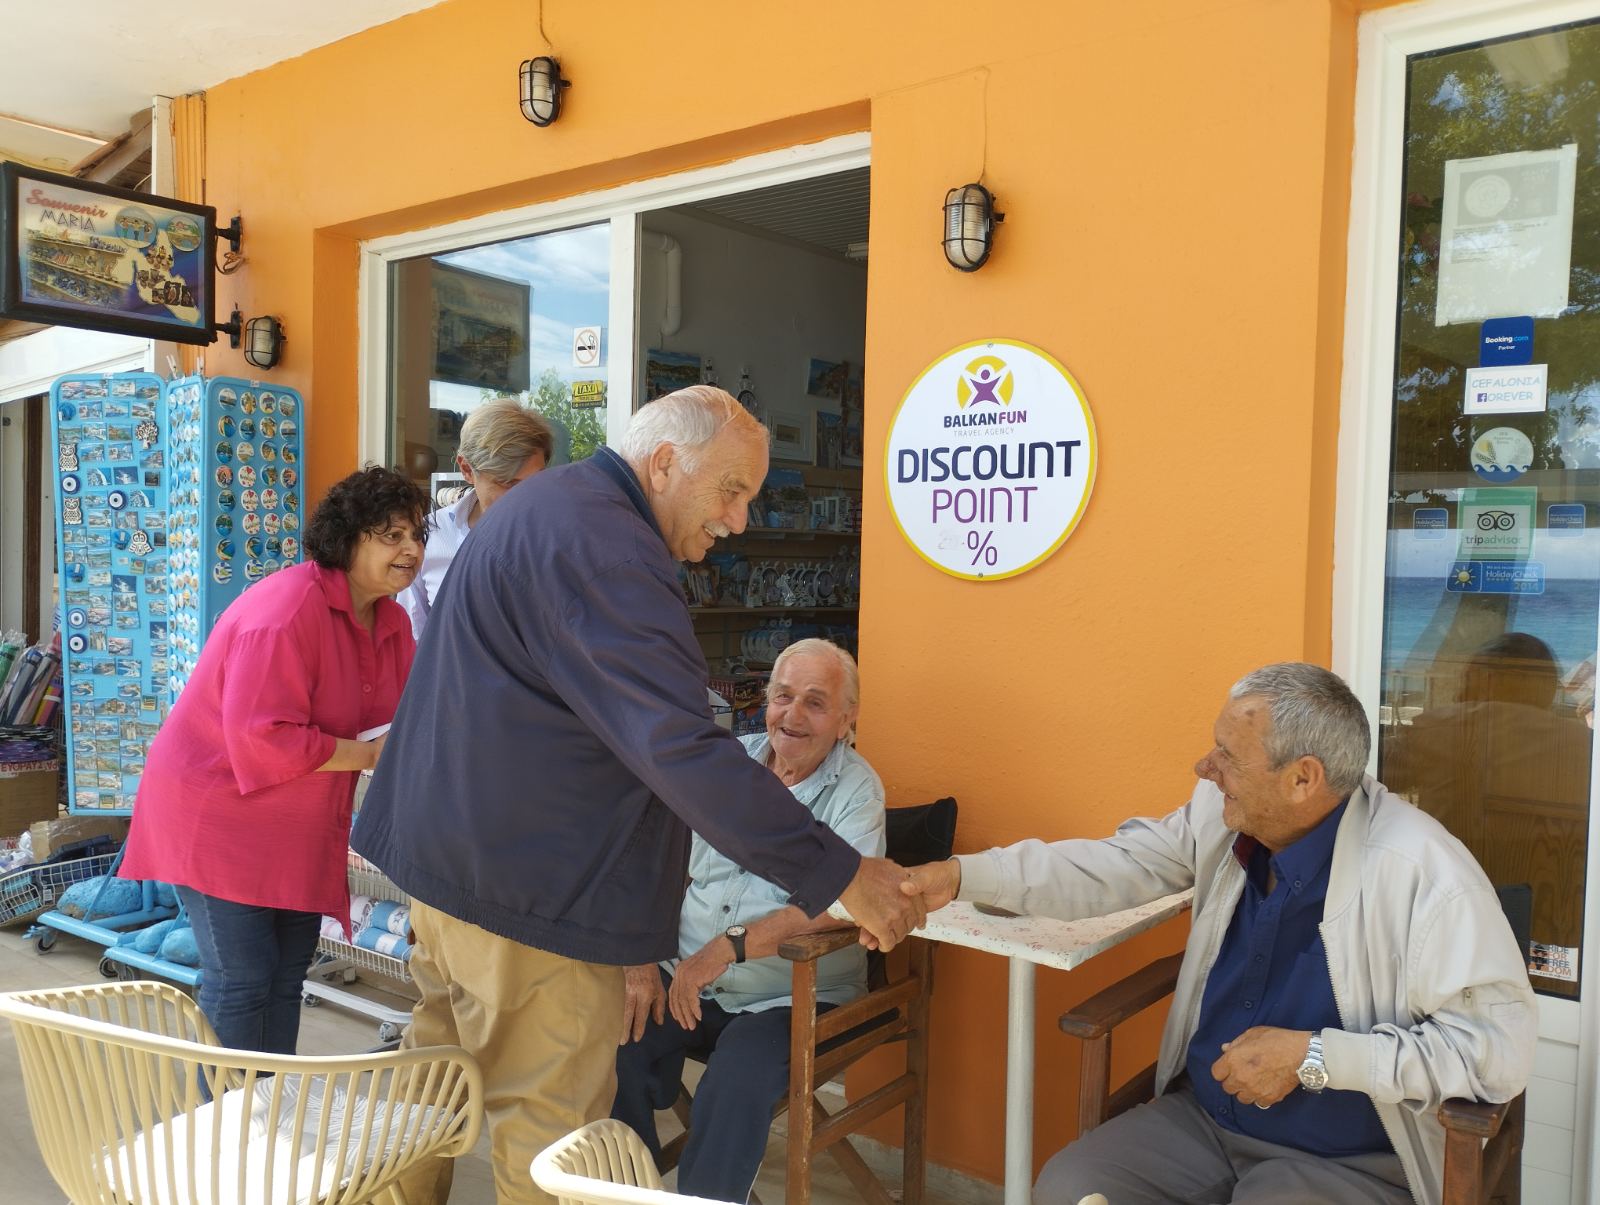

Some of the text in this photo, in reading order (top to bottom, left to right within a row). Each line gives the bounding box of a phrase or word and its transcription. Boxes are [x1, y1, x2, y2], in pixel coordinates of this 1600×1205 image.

[27, 189, 108, 218] Souvenir
[40, 209, 95, 232] MARIA
[578, 384, 595, 394] TAXI
[1472, 377, 1541, 388] CEFALONIA
[953, 427, 1015, 438] TRAVEL AGENCY
[897, 440, 1081, 483] DISCOUNT
[932, 486, 1038, 524] POINT
[967, 530, 998, 566] %
[1486, 570, 1538, 579] HolidayCheck
